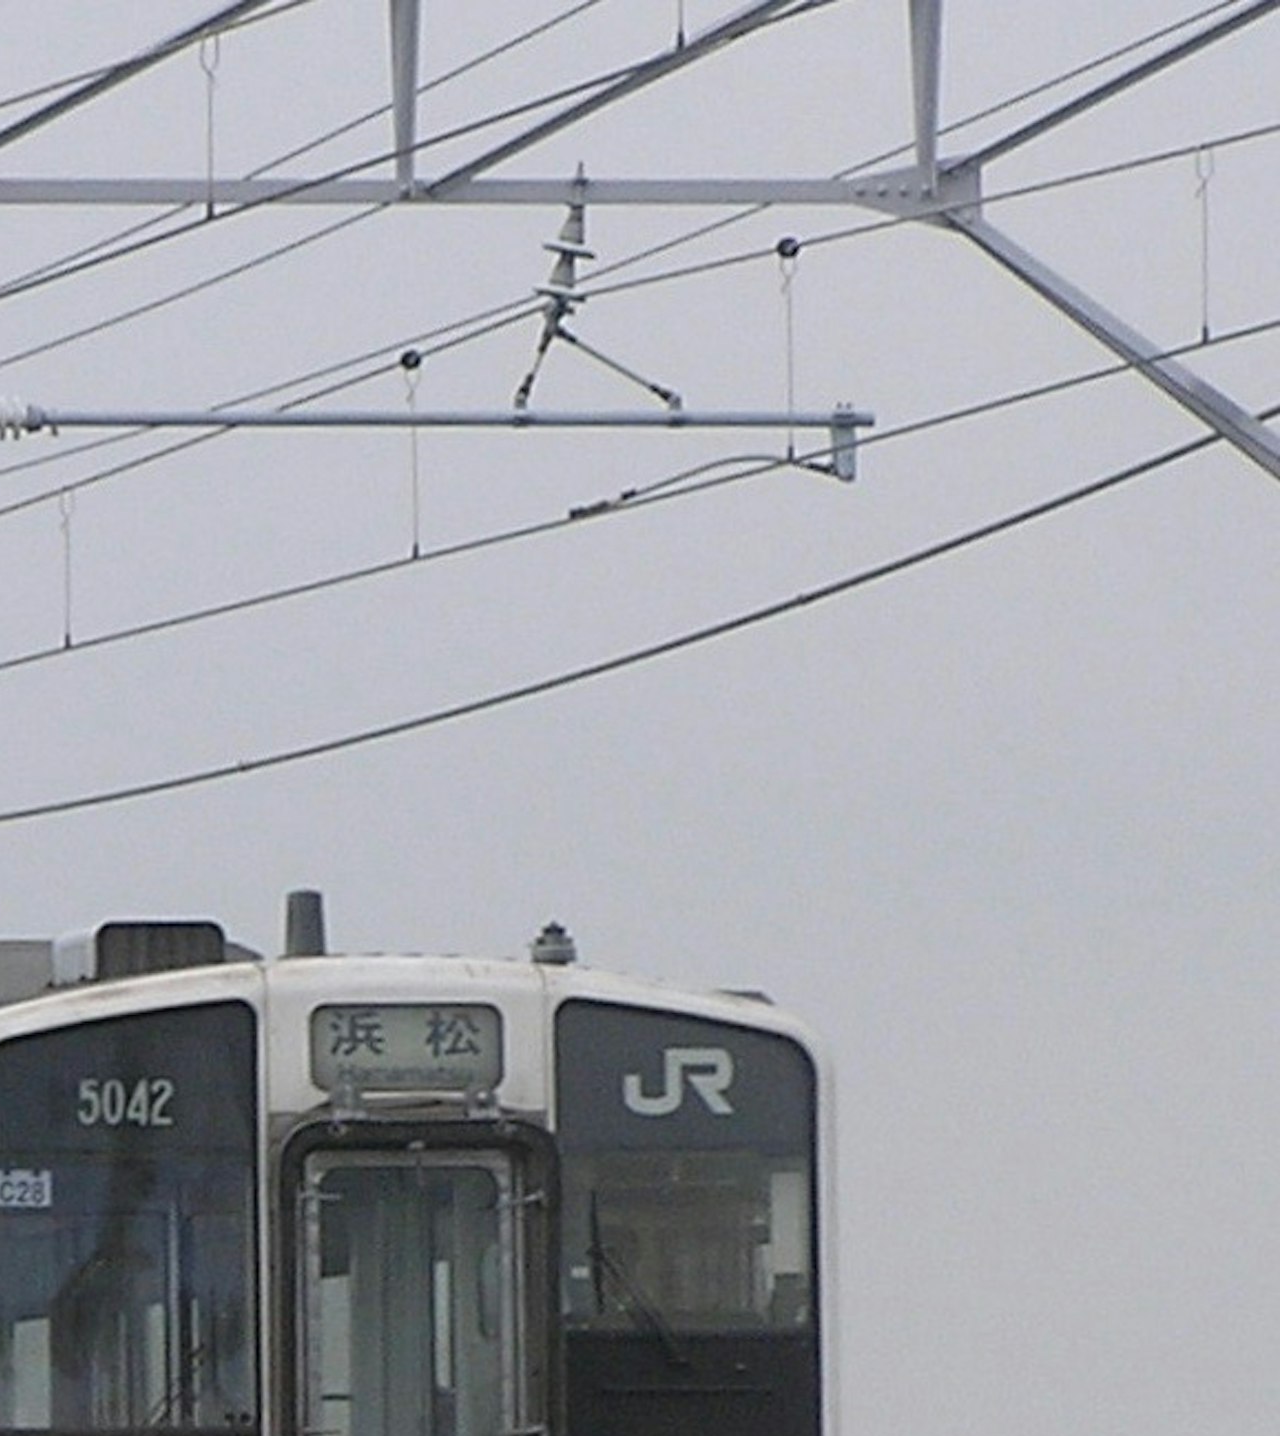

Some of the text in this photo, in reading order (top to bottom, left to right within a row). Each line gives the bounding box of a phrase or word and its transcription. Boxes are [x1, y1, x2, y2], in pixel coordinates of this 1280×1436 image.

[329, 1010, 482, 1057] 浜松
[77, 1078, 175, 1127] 5042
[623, 1047, 734, 1115] JR
